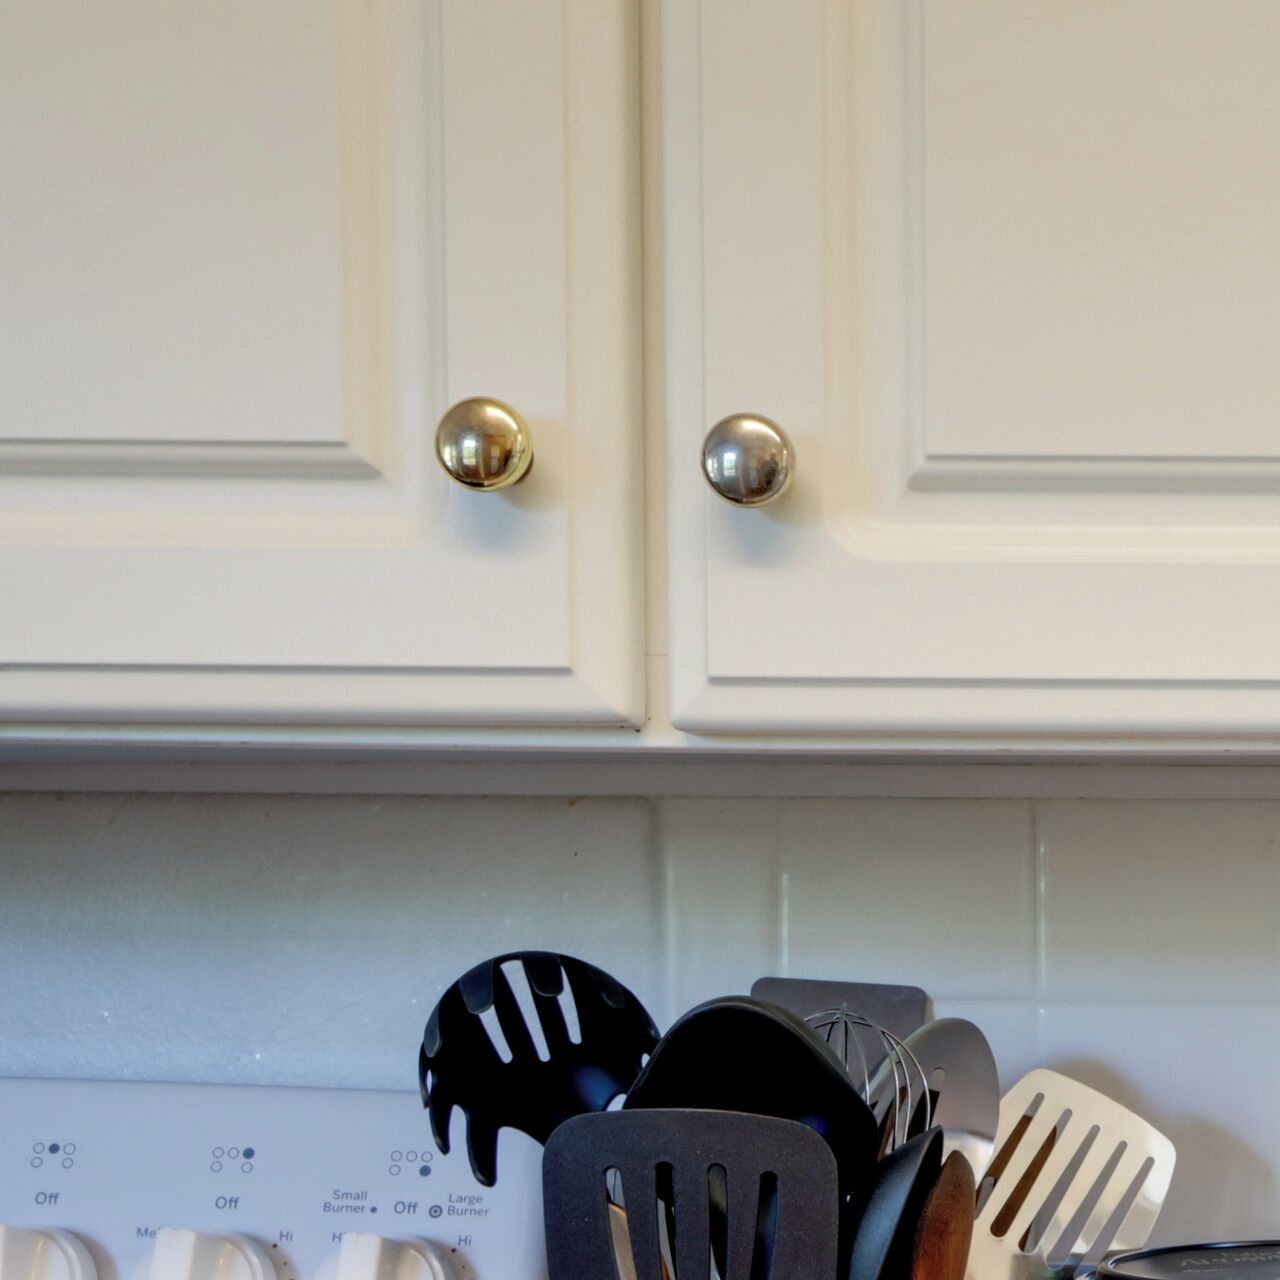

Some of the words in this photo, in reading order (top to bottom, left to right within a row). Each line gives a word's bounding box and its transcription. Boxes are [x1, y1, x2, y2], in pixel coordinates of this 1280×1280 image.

[34, 1191, 60, 1206] Off
[332, 1189, 368, 1201] Small
[449, 1194, 483, 1207] Large
[215, 1196, 240, 1210] Off
[323, 1202, 365, 1213] Burner
[394, 1201, 418, 1214] Off
[447, 1206, 489, 1217] Burner
[279, 1230, 294, 1242] Hi
[458, 1235, 472, 1246] Hi
